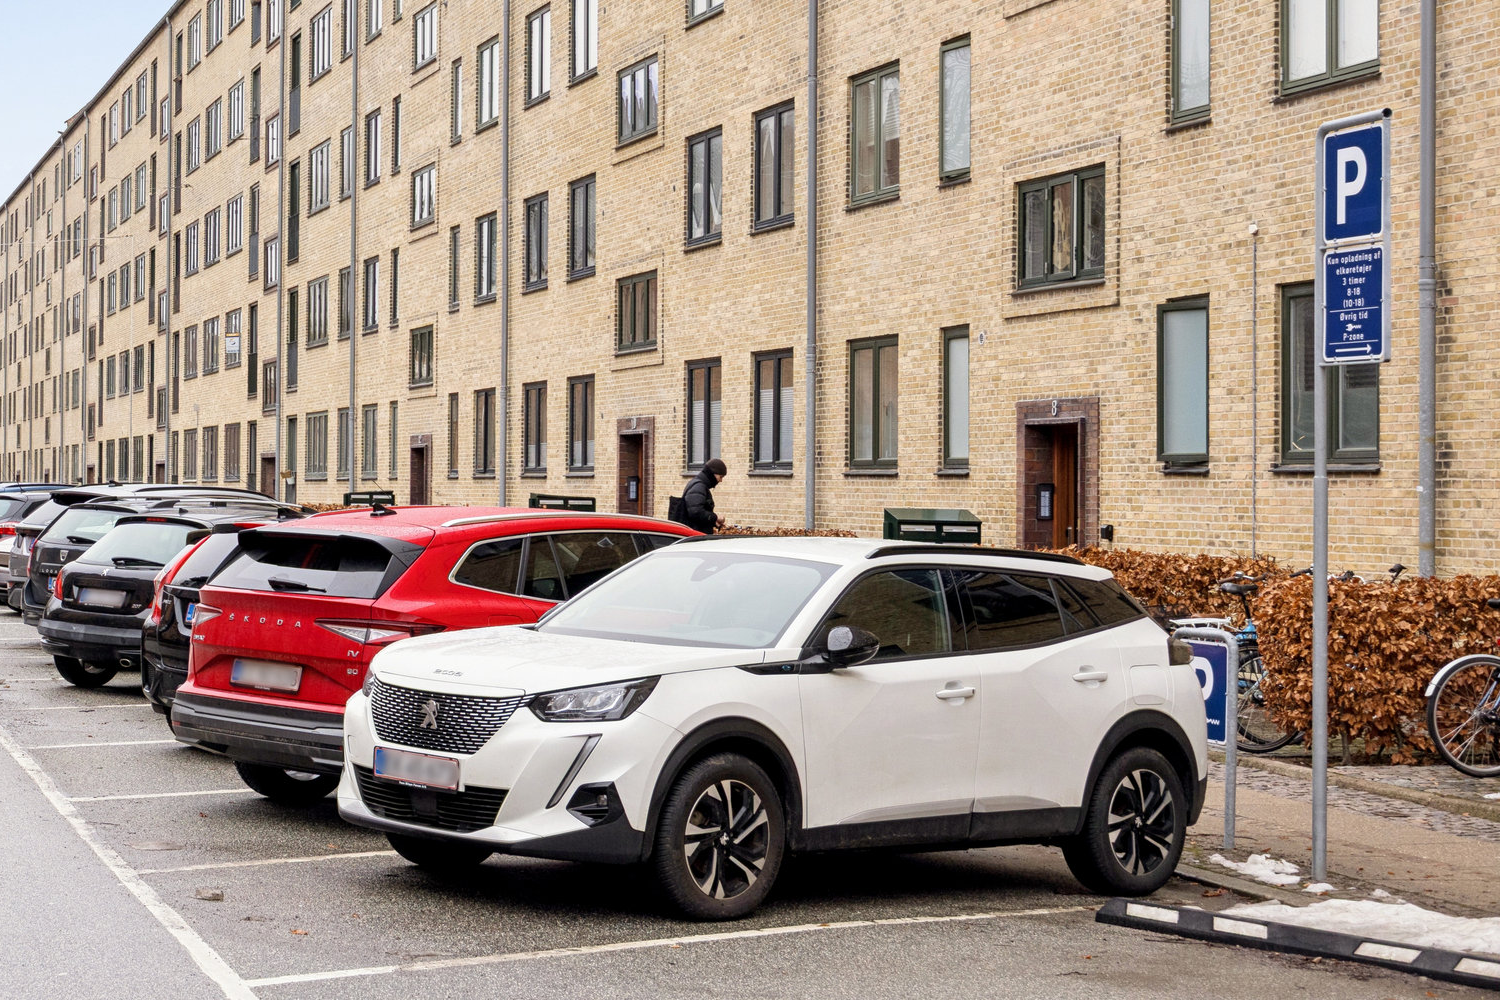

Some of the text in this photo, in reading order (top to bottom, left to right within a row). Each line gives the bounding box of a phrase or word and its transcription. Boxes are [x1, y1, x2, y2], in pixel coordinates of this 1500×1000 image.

[1336, 146, 1368, 225] P
[1327, 250, 1381, 265] Kun opladning af
[1336, 264, 1372, 275] elkøretøjer
[1342, 277, 1366, 286] 3 timer
[1346, 287, 1361, 296] 8-18
[1343, 298, 1365, 308] (10-18)
[1340, 311, 1368, 322] Øvrig tid
[1343, 333, 1364, 341] P-zone
[1051, 400, 1057, 416] 8
[228, 613, 302, 628] ŠKODA
